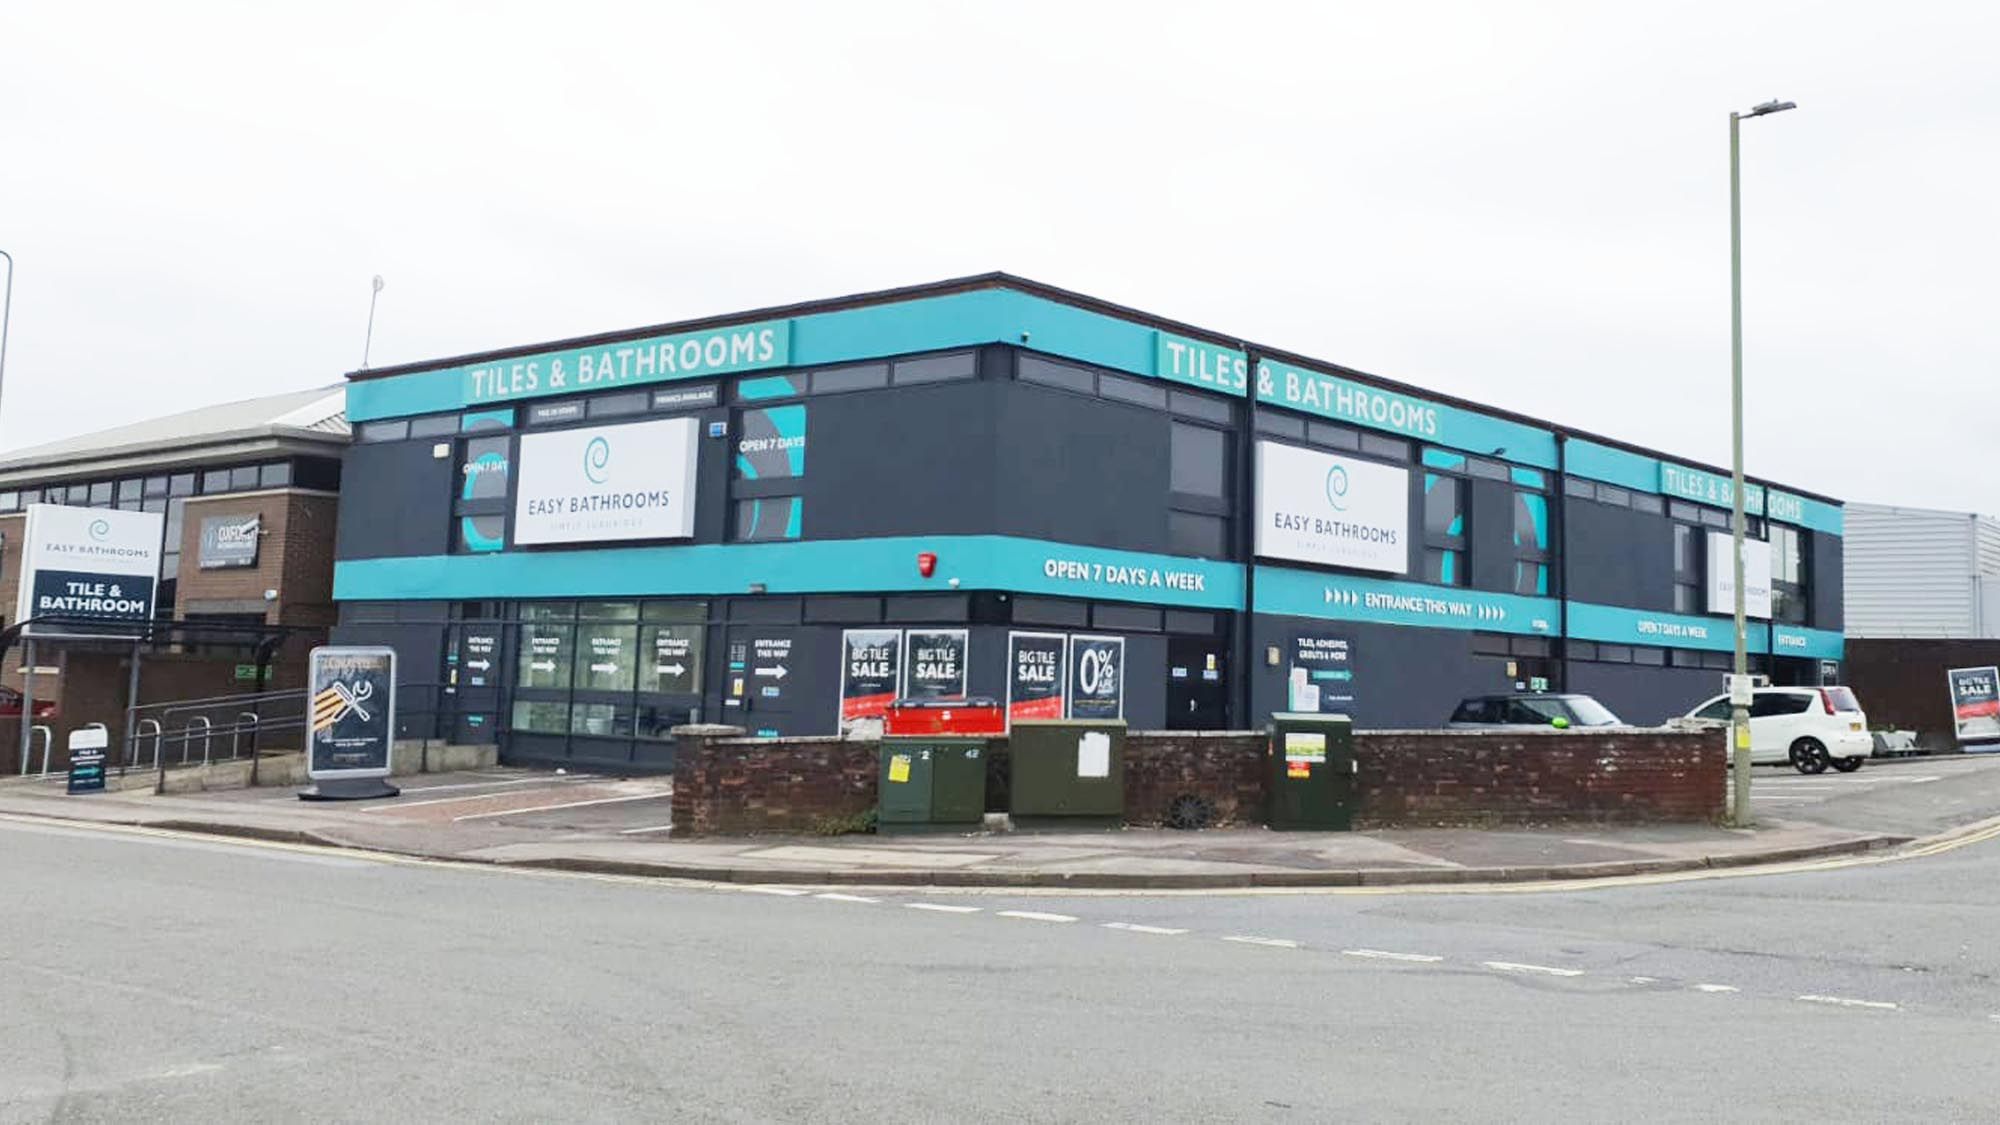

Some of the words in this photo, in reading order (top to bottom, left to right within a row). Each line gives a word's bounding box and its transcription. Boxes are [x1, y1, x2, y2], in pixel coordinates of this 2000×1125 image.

[472, 364, 539, 398] TILES
[549, 359, 566, 387] &
[578, 329, 774, 384] BATHROOMS
[1167, 342, 1247, 389] TILES
[1257, 365, 1275, 397] &
[1286, 372, 1437, 436] BATHROOMS
[740, 440, 767, 452] OPEN
[768, 439, 775, 450] 7
[777, 436, 805, 449] DAYS
[463, 461, 487, 475] OPEN
[1665, 469, 1702, 498] TILES
[1708, 484, 1717, 501] &
[529, 497, 565, 516] EASY
[570, 491, 669, 513] BATHROOMS
[1274, 512, 1309, 532] EASY
[1315, 519, 1397, 545] BATHROOMS
[46, 543, 75, 553] EASY
[79, 545, 149, 558] BATHROOMS
[1044, 559, 1089, 580] OPEN
[1093, 564, 1101, 581] 7
[1106, 565, 1146, 586] DAYS
[1150, 570, 1160, 587] A
[1165, 571, 1205, 591] WEEK
[67, 582, 105, 596] TILE
[109, 584, 122, 597] &
[40, 596, 145, 613] BATHROOM
[1365, 592, 1423, 612] ENTRANCE
[1424, 598, 1447, 614] THIS
[1447, 602, 1472, 616] WAY
[755, 639, 791, 648] ENTRANCE
[852, 648, 867, 660] BIG
[870, 648, 889, 660] TILE
[918, 650, 933, 661] BIG
[936, 648, 956, 662] TILE
[1018, 650, 1035, 663] BIG
[1036, 652, 1055, 664] TILE
[851, 662, 889, 677] SALE
[915, 663, 956, 679] SALE
[1018, 665, 1055, 681] SALE
[1080, 649, 1113, 694] 0%
[1960, 684, 1992, 696] SALE
